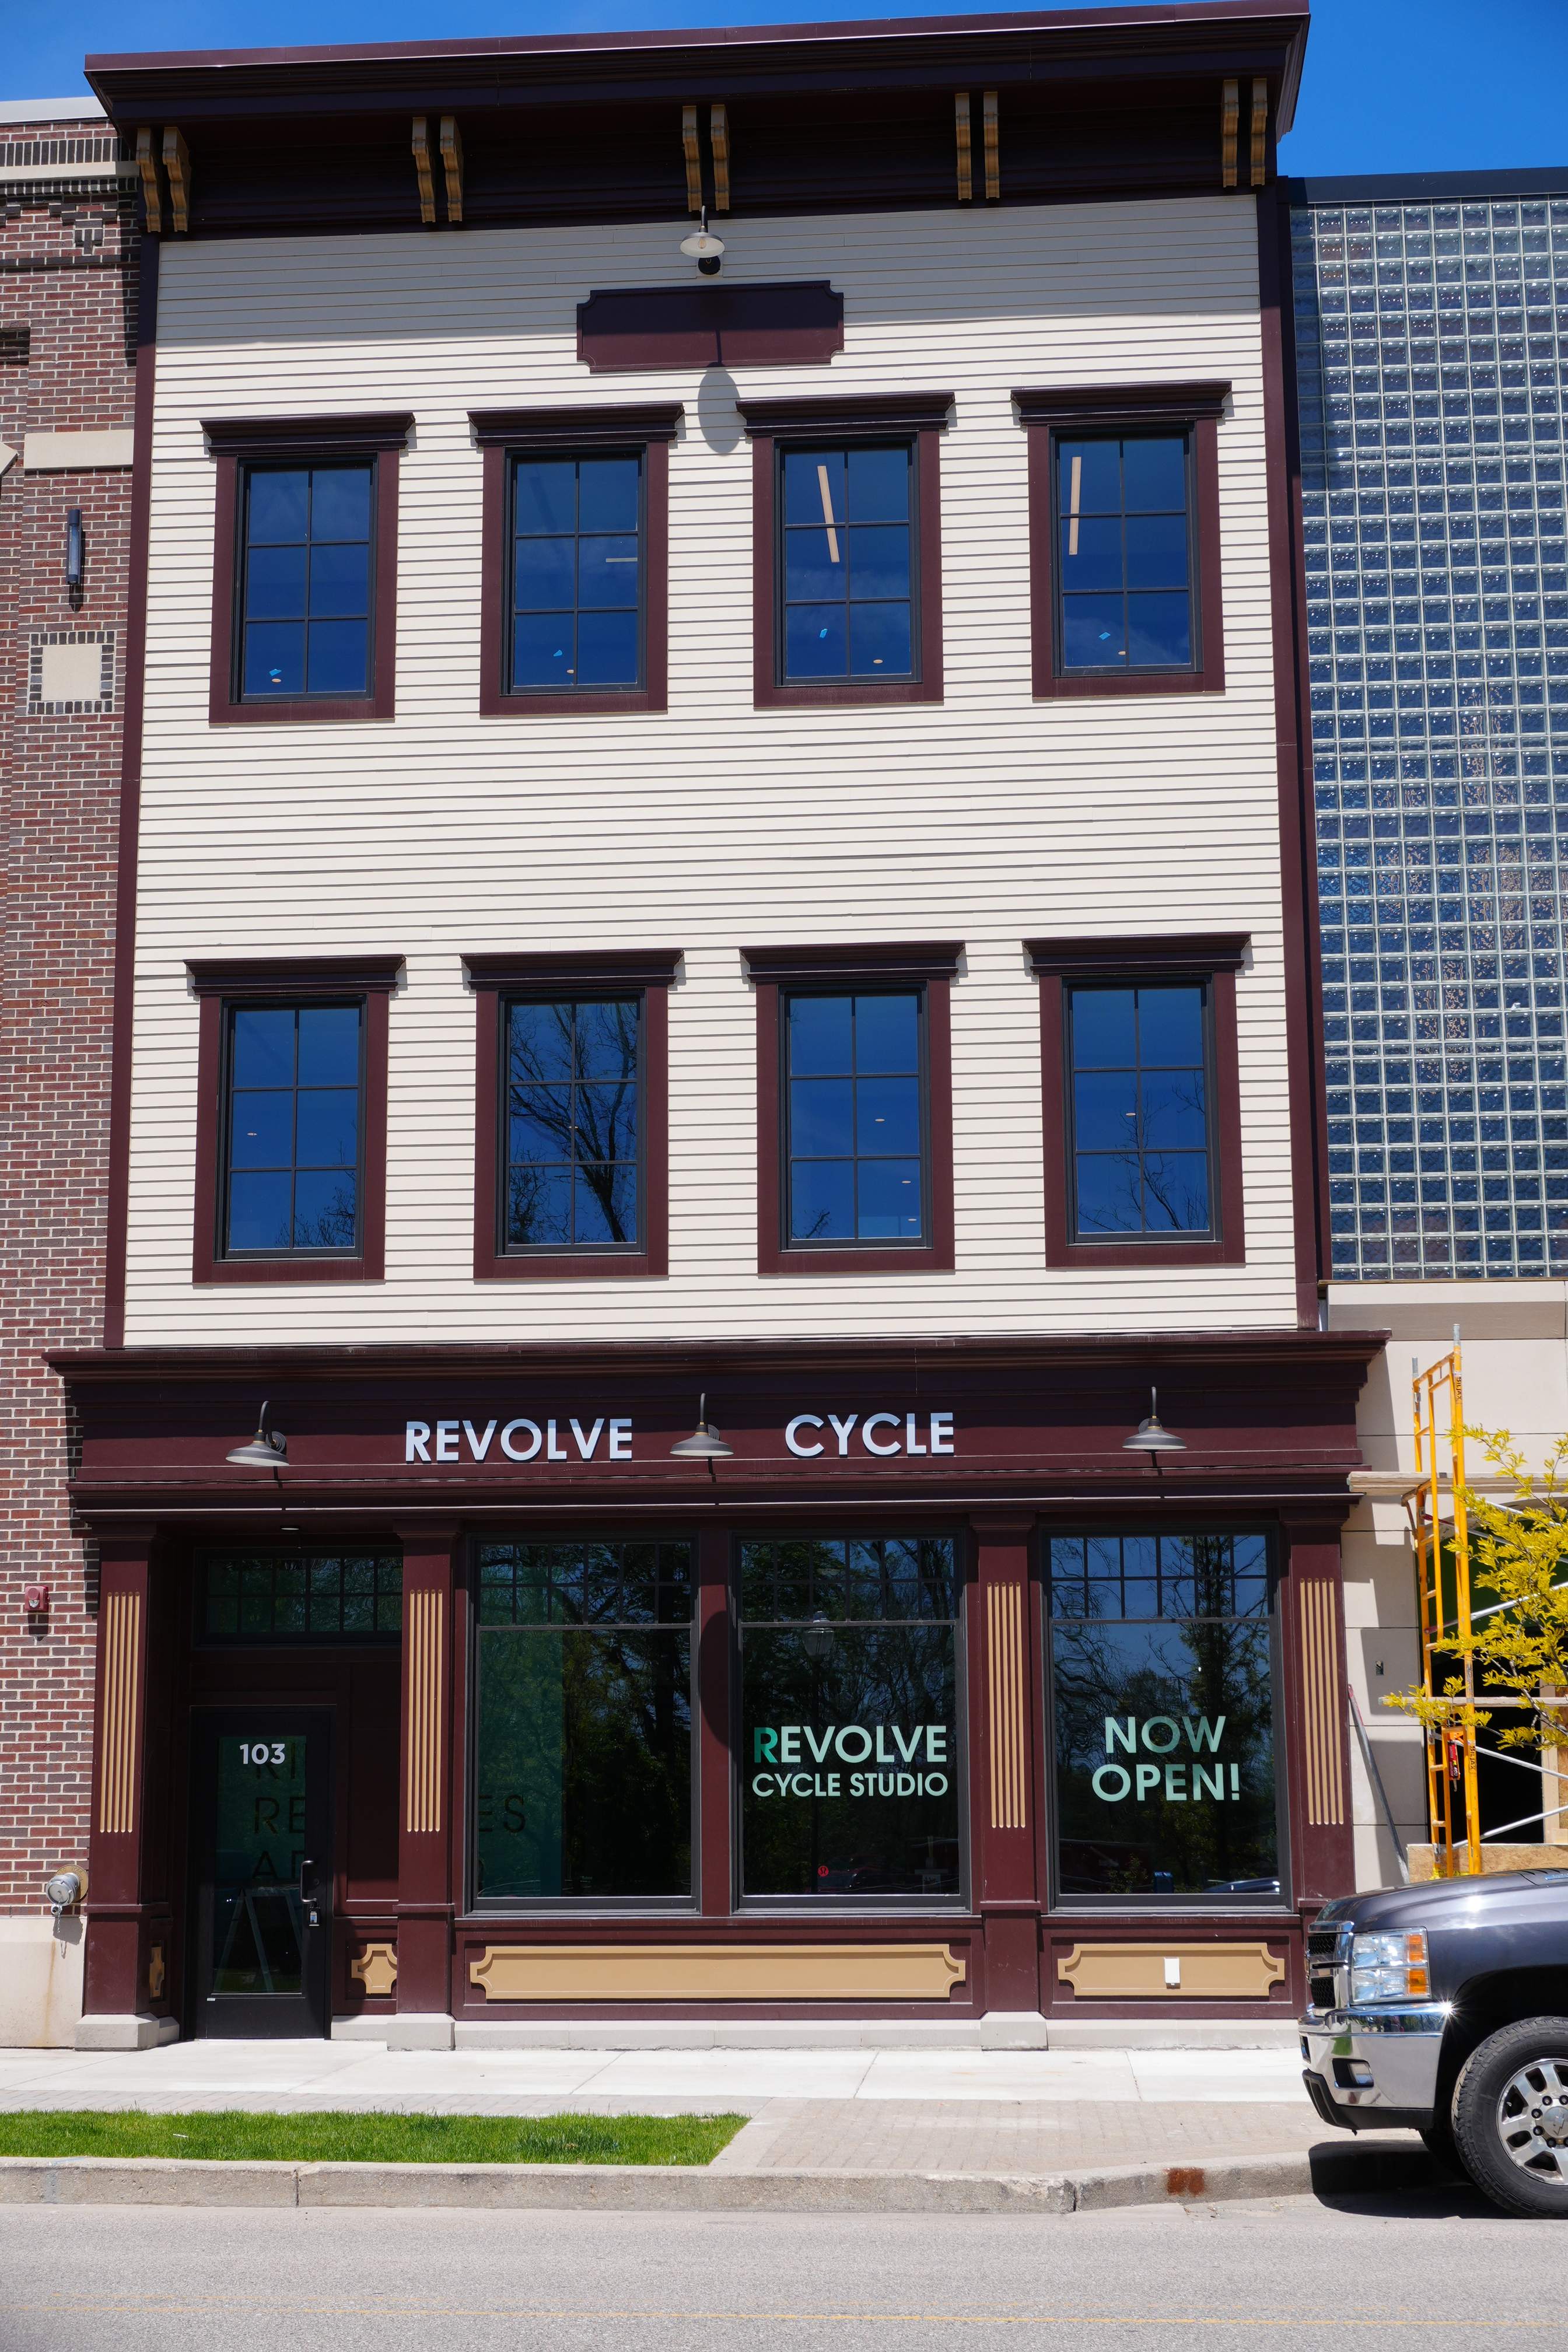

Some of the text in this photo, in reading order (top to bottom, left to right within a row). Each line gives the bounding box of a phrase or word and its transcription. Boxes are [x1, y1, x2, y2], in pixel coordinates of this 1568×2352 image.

[405, 1412, 955, 1461] REVOLVE CYCLE
[239, 1743, 286, 1765] 103
[754, 1725, 947, 1763] REVOLVE
[1104, 1716, 1226, 1754] NOW
[752, 1772, 949, 1797] CYCLE STUDIO
[1091, 1763, 1240, 1802] OPEN!
